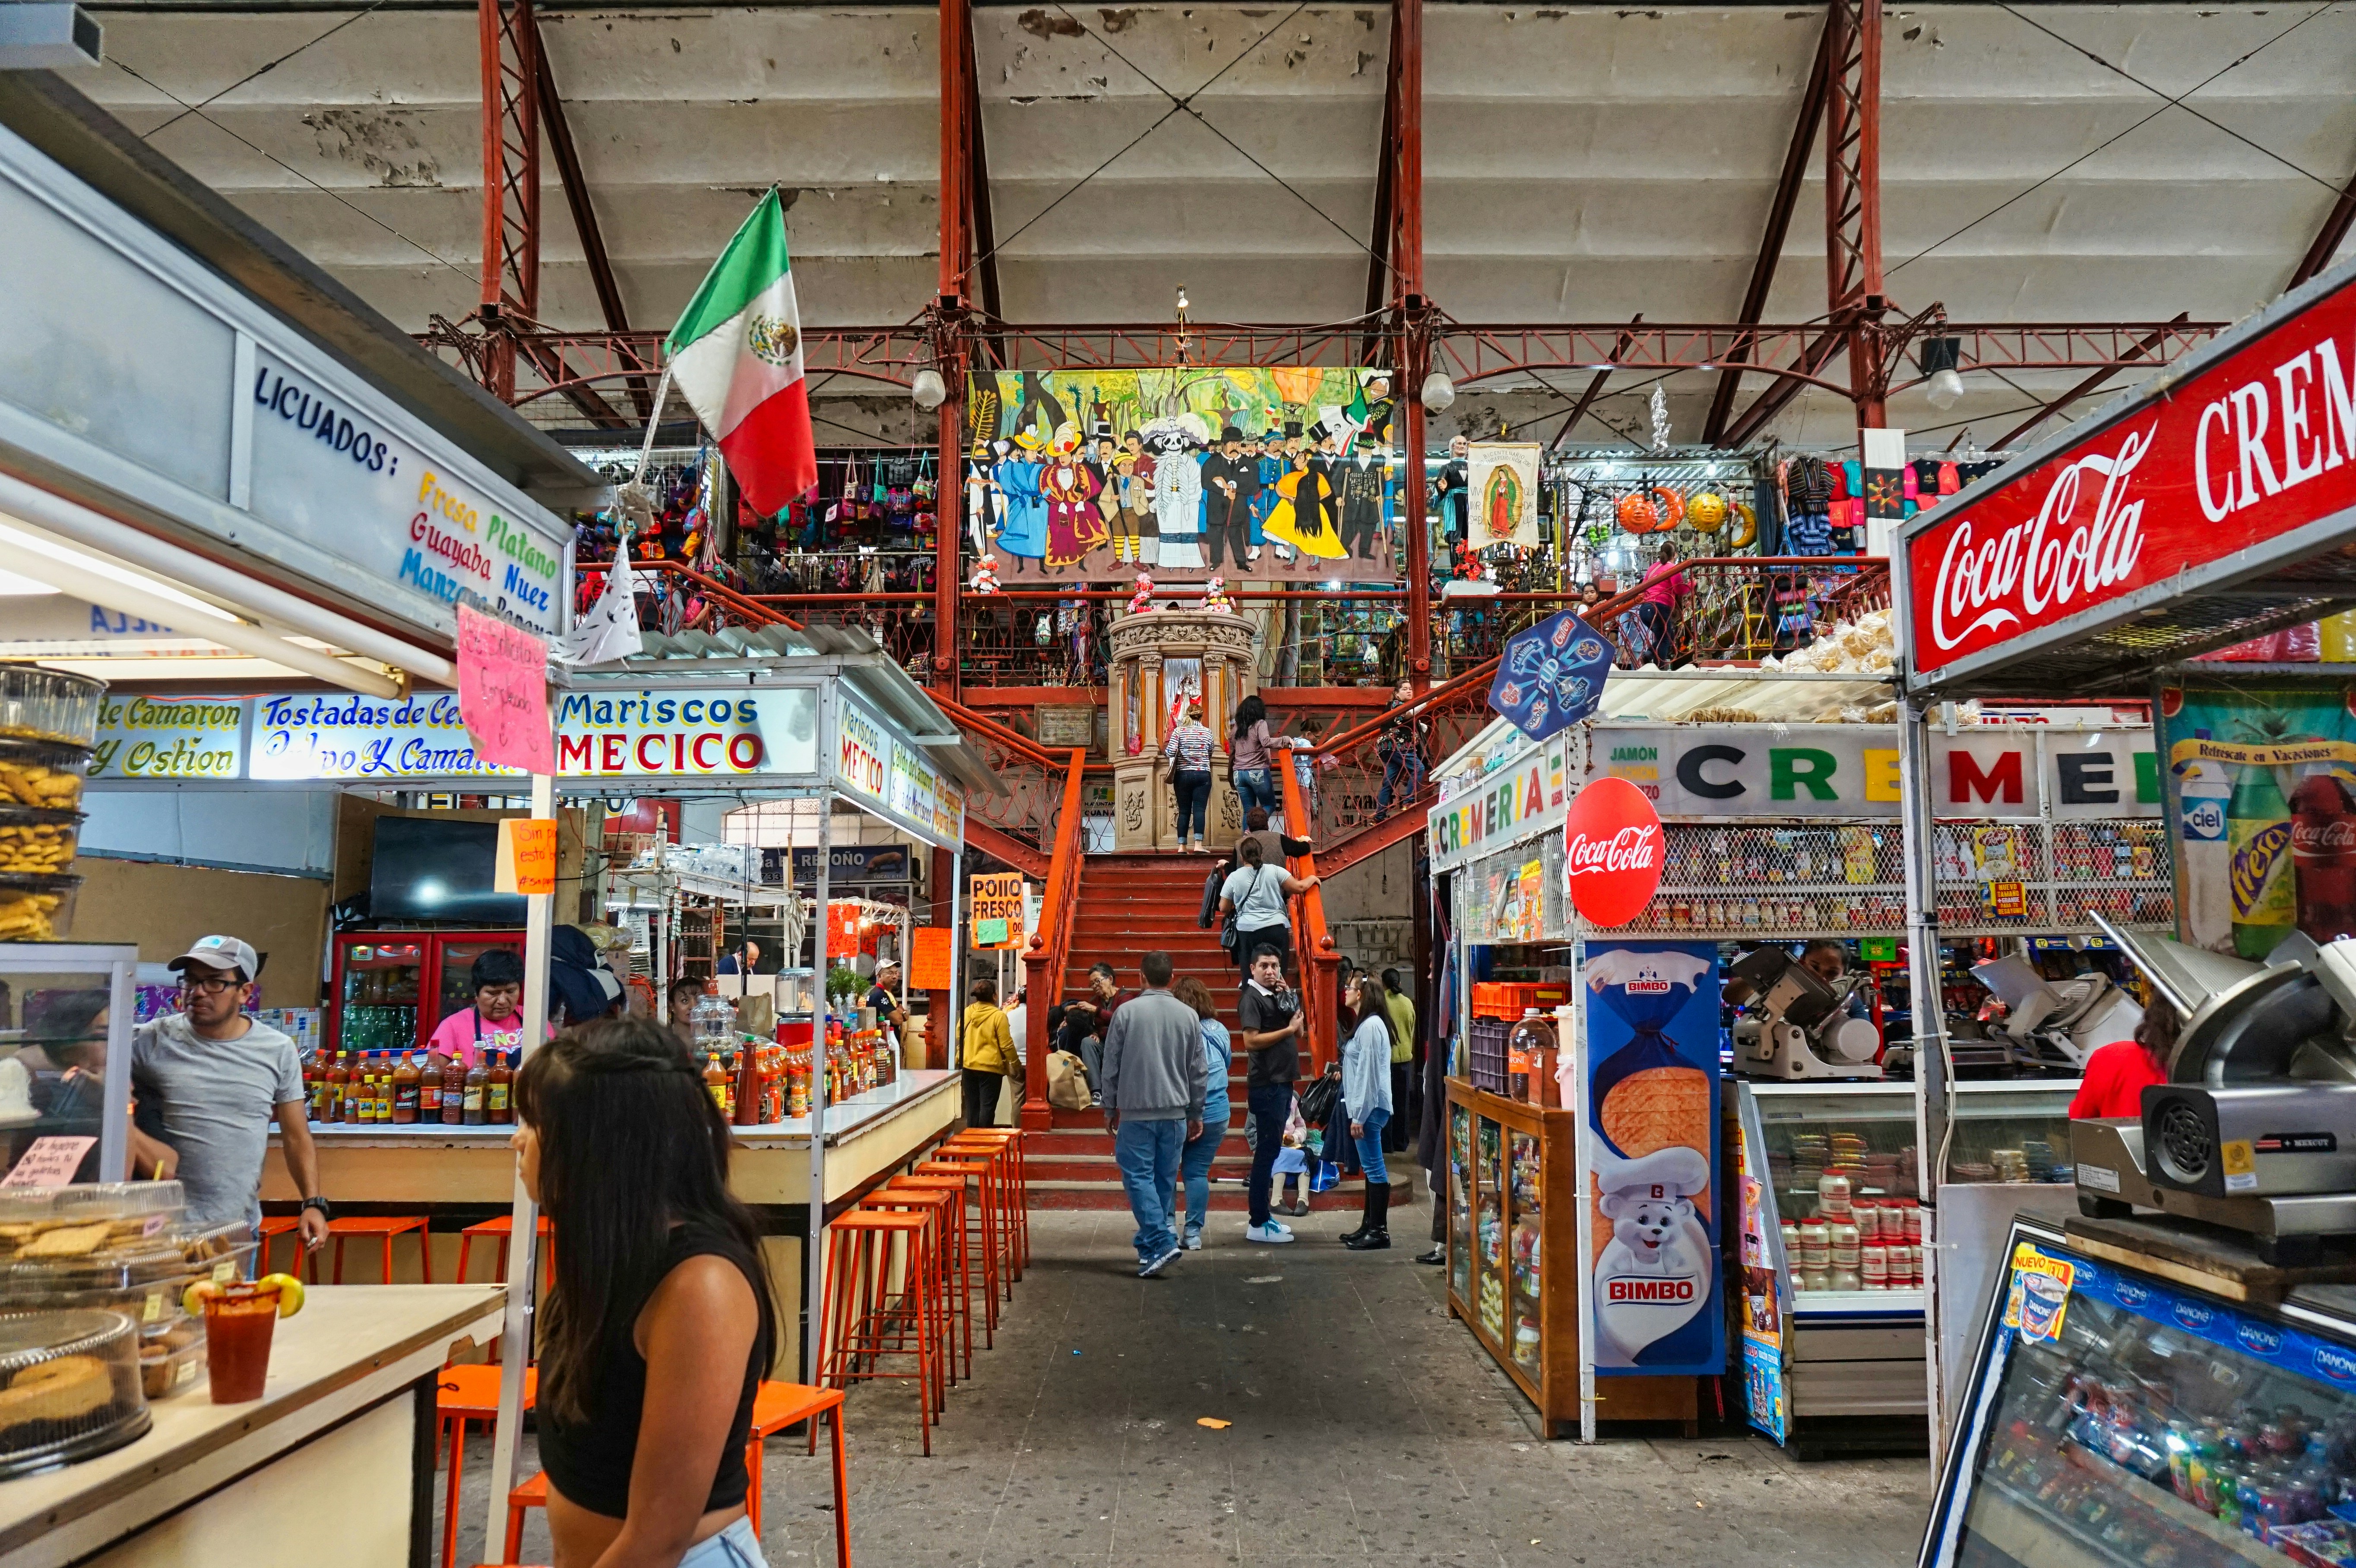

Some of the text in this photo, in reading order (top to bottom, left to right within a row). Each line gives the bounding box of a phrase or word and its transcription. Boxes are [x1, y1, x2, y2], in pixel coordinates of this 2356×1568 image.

[254, 367, 398, 476] LICUADOS:
[1483, 450, 1525, 459] BICENTENARIO
[1486, 455, 1521, 465] INDEPENDENCIA
[419, 471, 556, 579] Fresa Platano
[1933, 418, 2158, 650] Coca-Cola
[411, 512, 549, 612] Guayaba Nuez
[1539, 658, 1559, 694] FUD
[128, 697, 241, 726] Camaron
[264, 696, 388, 727] Tostadas
[396, 697, 425, 725] de
[560, 690, 758, 726] Mariscos
[1562, 695, 1573, 708] SAN
[842, 700, 879, 751] Mariscos
[560, 732, 764, 773] MECICO
[2253, 752, 2265, 762] en
[2272, 746, 2331, 762] Vacaciones
[1439, 766, 1544, 854] CREMERIA
[2193, 808, 2220, 828] ciel
[519, 823, 542, 841] Sin
[1568, 824, 1659, 876] Coca-Cola
[973, 901, 1022, 919] FRESCO
[1628, 982, 1668, 991] BIMBO
[2015, 1256, 2046, 1268] NUEVO
[1609, 1281, 1694, 1300] BIMBO
